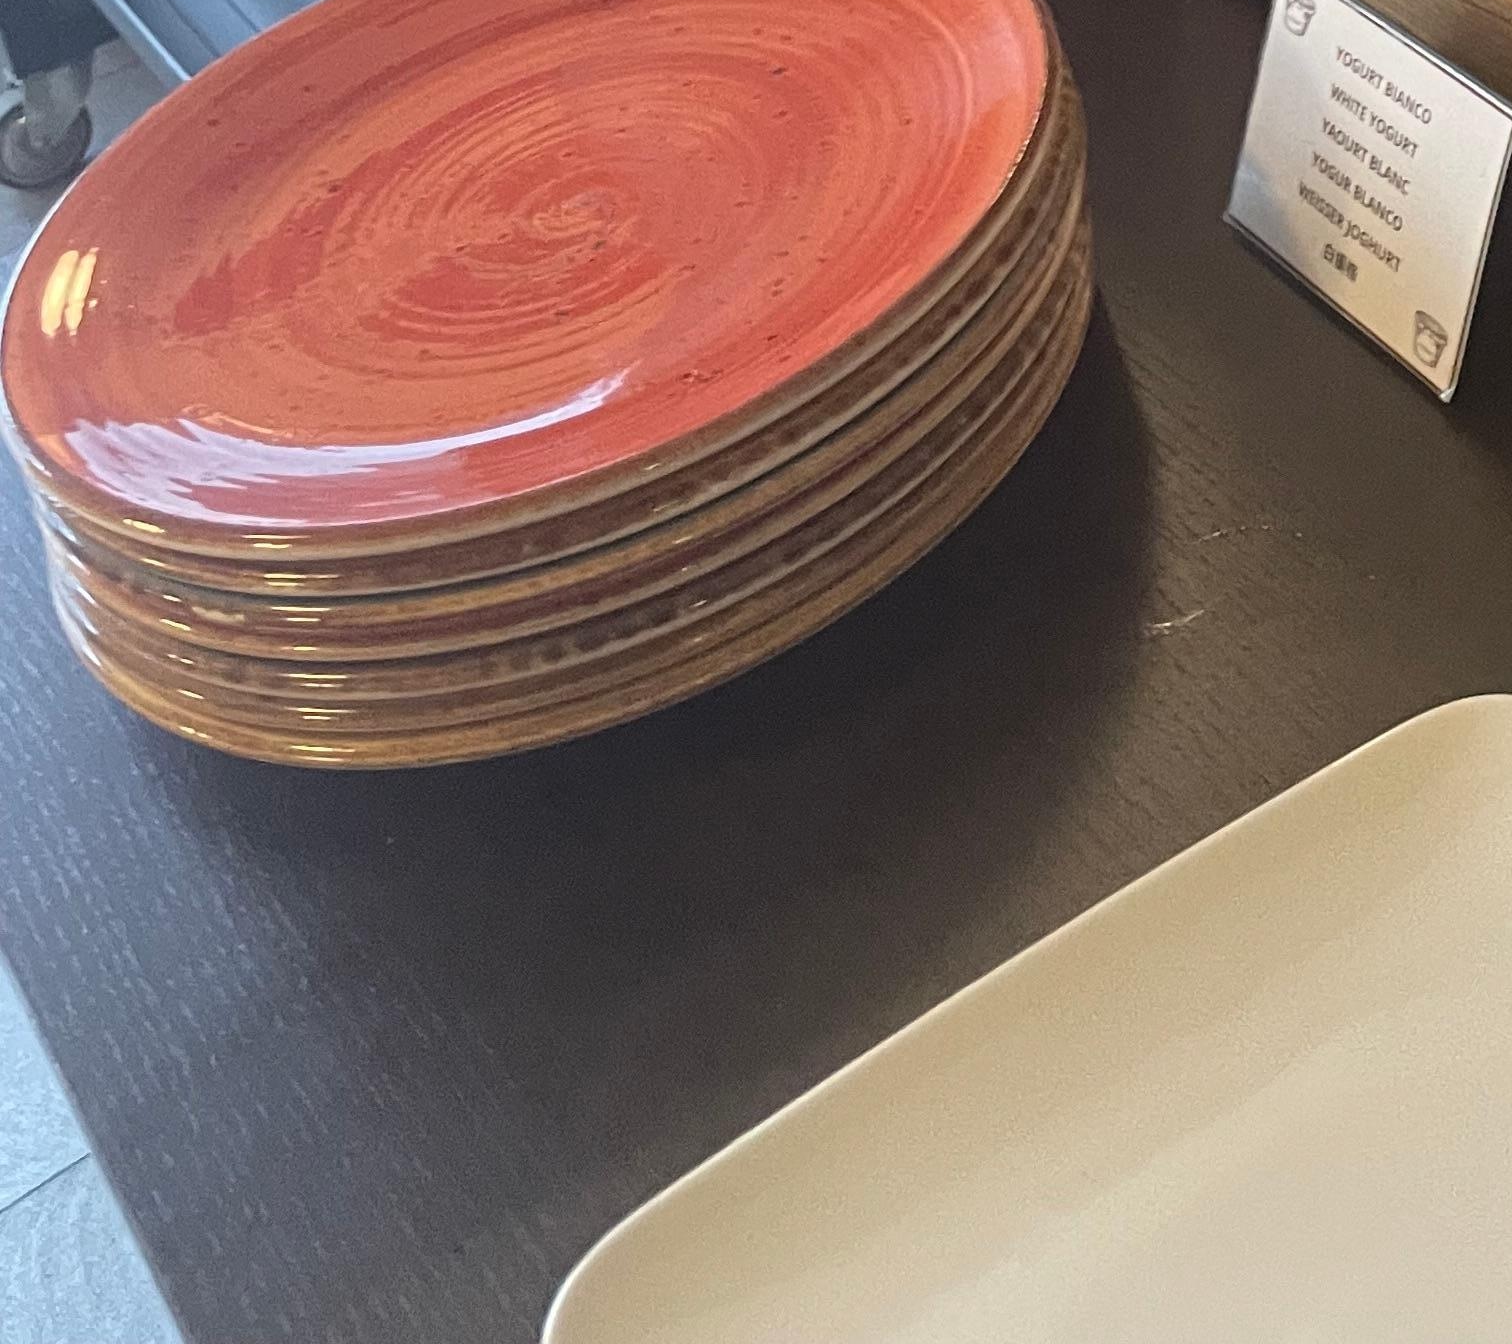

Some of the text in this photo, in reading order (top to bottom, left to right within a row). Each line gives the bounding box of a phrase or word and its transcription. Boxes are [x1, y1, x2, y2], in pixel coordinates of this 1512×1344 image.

[1329, 83, 1418, 159] WHITE YOGURT
[1335, 45, 1433, 124] YOGURT BIANCO
[1311, 151, 1404, 232] YOGUR BLANCO
[1321, 118, 1412, 196] YAOURT BLANC
